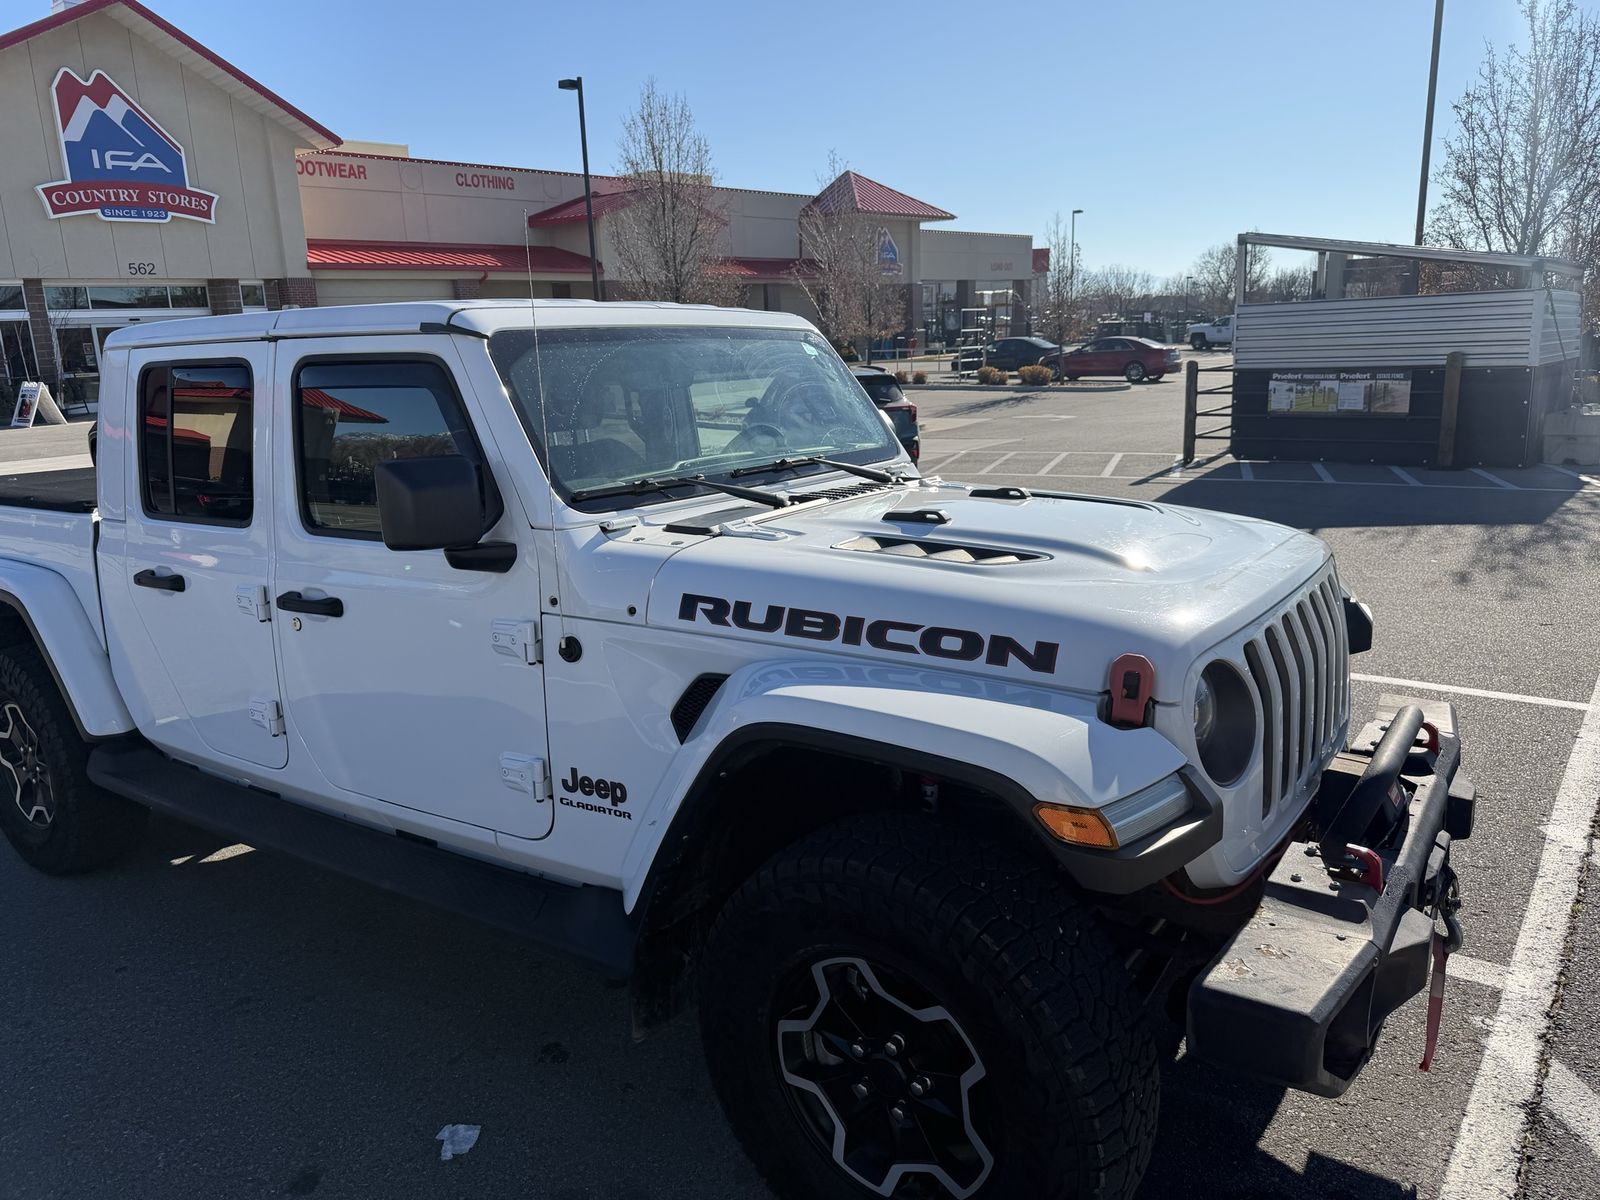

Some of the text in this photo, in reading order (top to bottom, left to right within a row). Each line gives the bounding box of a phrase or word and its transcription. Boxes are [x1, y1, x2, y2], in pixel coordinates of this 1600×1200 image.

[91, 149, 172, 173] IFA
[455, 172, 515, 190] CLOTHING
[51, 188, 209, 211] COUNTRY STORES
[104, 208, 166, 218] SINCE 1923
[128, 262, 157, 276] 562
[678, 593, 1060, 675] RUBICON
[561, 767, 627, 807] Jeep
[559, 797, 632, 820] GLADIATOR
